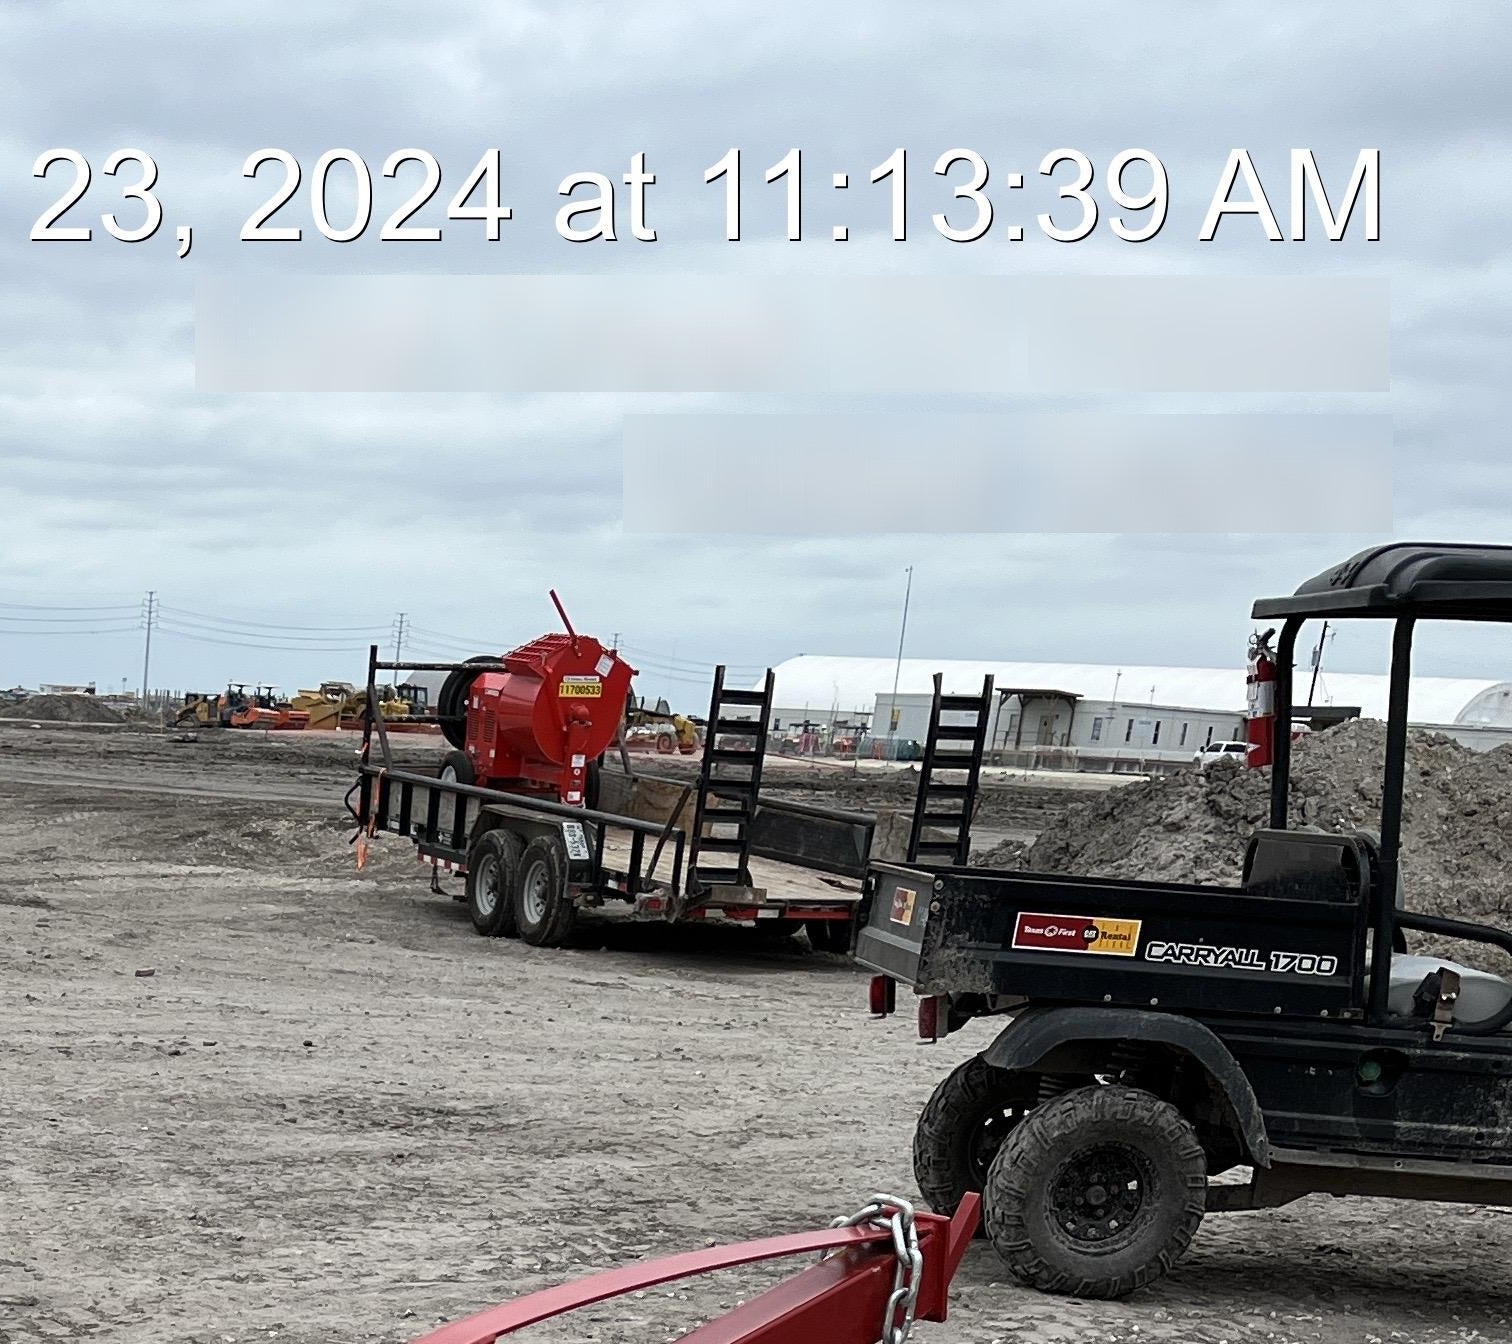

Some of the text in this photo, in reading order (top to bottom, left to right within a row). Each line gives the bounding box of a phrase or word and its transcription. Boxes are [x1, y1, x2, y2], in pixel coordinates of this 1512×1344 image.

[560, 684, 601, 695] 11700533
[1100, 931, 1131, 941] Rental
[1145, 941, 1338, 976] CARRYALL 1700
